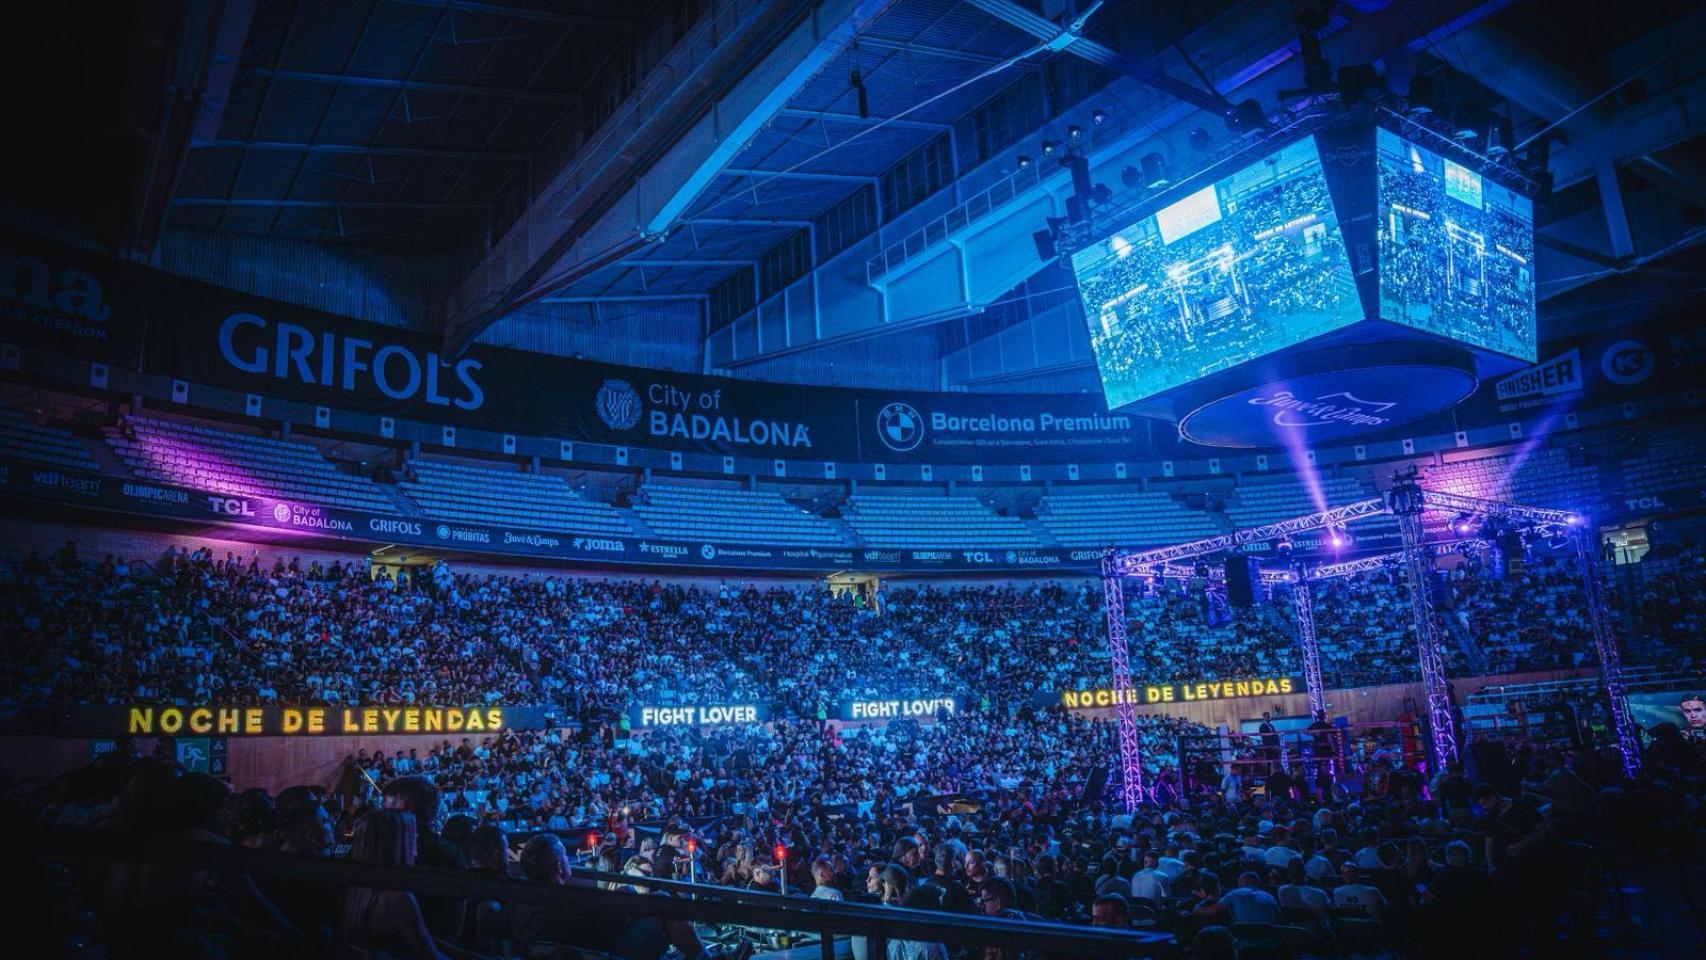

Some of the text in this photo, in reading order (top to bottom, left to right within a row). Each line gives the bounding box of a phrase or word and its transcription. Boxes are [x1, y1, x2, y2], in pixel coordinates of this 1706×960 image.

[218, 312, 484, 410] GRIFOLS
[1497, 358, 1574, 399] FINISHER
[648, 384, 722, 412] City of
[649, 410, 812, 448] BADALONA
[931, 411, 1131, 432] Barcelona Premium
[208, 496, 256, 516] TCL
[293, 505, 321, 517] City of
[1624, 495, 1665, 511] TCL
[293, 515, 354, 532] BADALONA
[369, 518, 422, 536] GRIFOLS
[452, 530, 490, 543] PROBITAS
[651, 545, 688, 555] ESTRELLA
[963, 551, 994, 563] TCL
[1018, 556, 1061, 565] BADALONA
[1147, 685, 1173, 703] DE
[1183, 678, 1293, 701] LEYENDAS
[642, 706, 757, 726] FIGHT LOVER
[852, 700, 900, 718] FIGHT
[128, 707, 504, 734] NOCHE DE LEYENDAS
